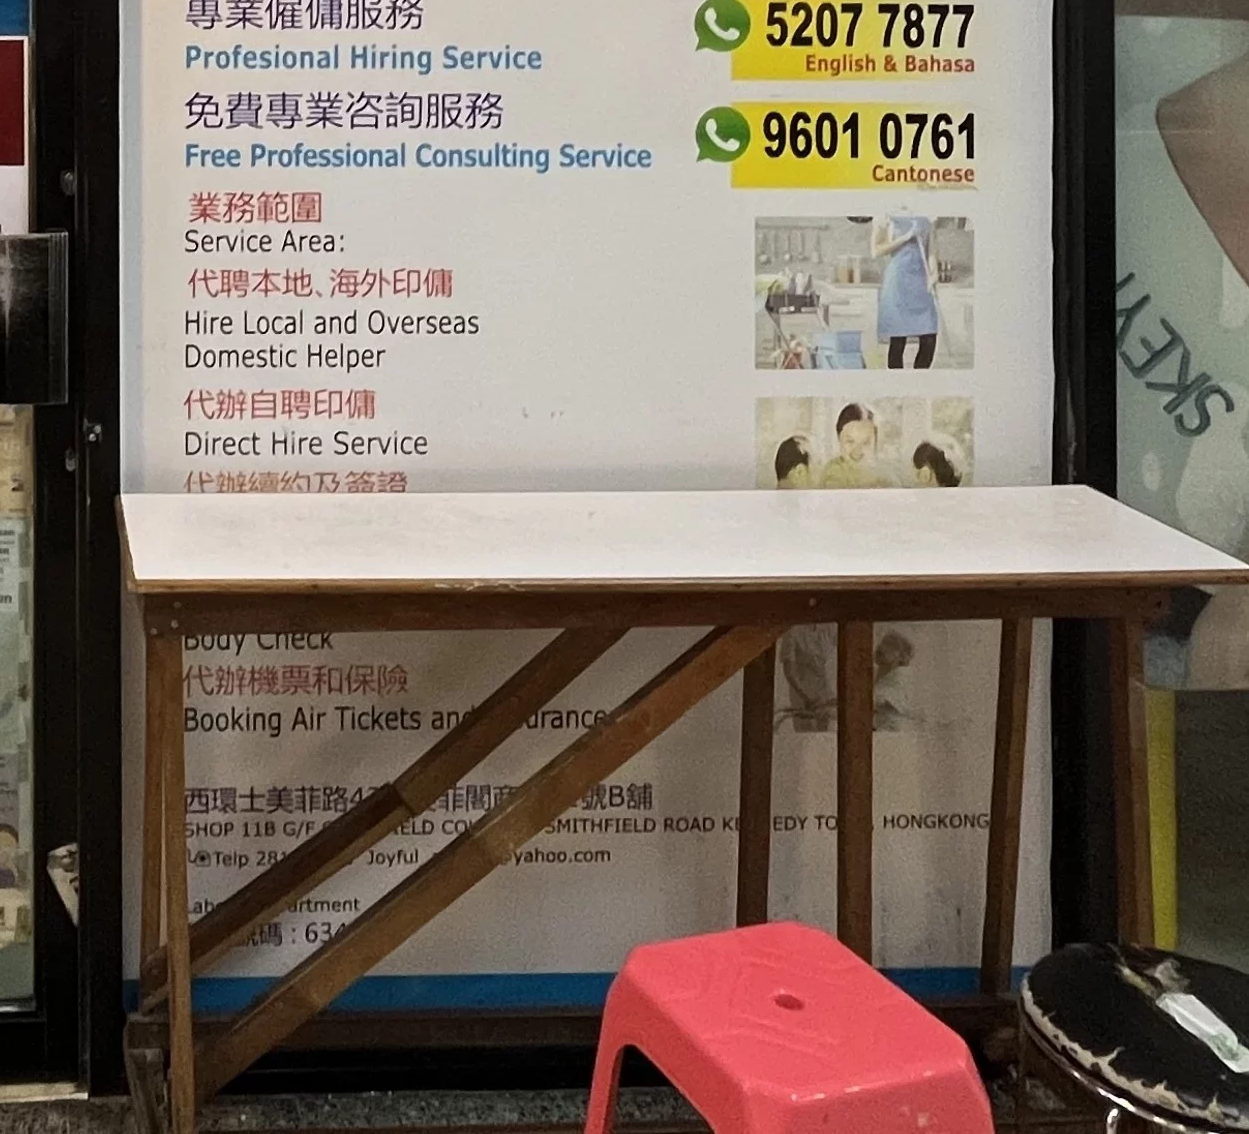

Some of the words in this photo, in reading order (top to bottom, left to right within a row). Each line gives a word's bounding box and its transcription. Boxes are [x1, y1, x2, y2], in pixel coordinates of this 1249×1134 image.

[766, 2, 863, 47] 5207
[878, 3, 975, 48] 7877
[185, 45, 339, 70] Profesional
[350, 45, 432, 75] Hiring
[443, 45, 542, 71] Service
[805, 54, 876, 77] English
[883, 55, 897, 73] &
[905, 55, 975, 73] Bahasa
[763, 111, 859, 159] 9601
[879, 112, 975, 160] 0761
[185, 143, 241, 168] Free
[251, 142, 406, 168] Professional
[415, 142, 550, 173] Consulting
[559, 144, 652, 169] Service
[872, 164, 975, 183] Cantonese
[188, 191, 322, 223] 業務範圍
[184, 230, 272, 253] Service
[281, 230, 345, 253] Area:
[184, 310, 233, 335] Hire
[243, 310, 304, 335] Local
[314, 310, 357, 335] and
[368, 310, 479, 335] Overseas
[184, 344, 297, 368] Domestic
[307, 344, 386, 373] Helper
[183, 388, 376, 420] 代辦自聘印傭
[184, 432, 261, 456] Direct
[271, 432, 323, 456] Hire
[333, 431, 428, 456] Service
[184, 634, 246, 656] Body
[256, 634, 333, 650] Check
[184, 707, 282, 736] Booking
[292, 707, 327, 732] Air
[334, 706, 422, 731] Tickets
[184, 821, 234, 837] SHOP
[242, 821, 276, 837] 11B
[282, 821, 316, 839] G/F
[663, 817, 715, 833] ROAD
[882, 814, 990, 830] HONGKONG
[213, 850, 249, 868] Telp
